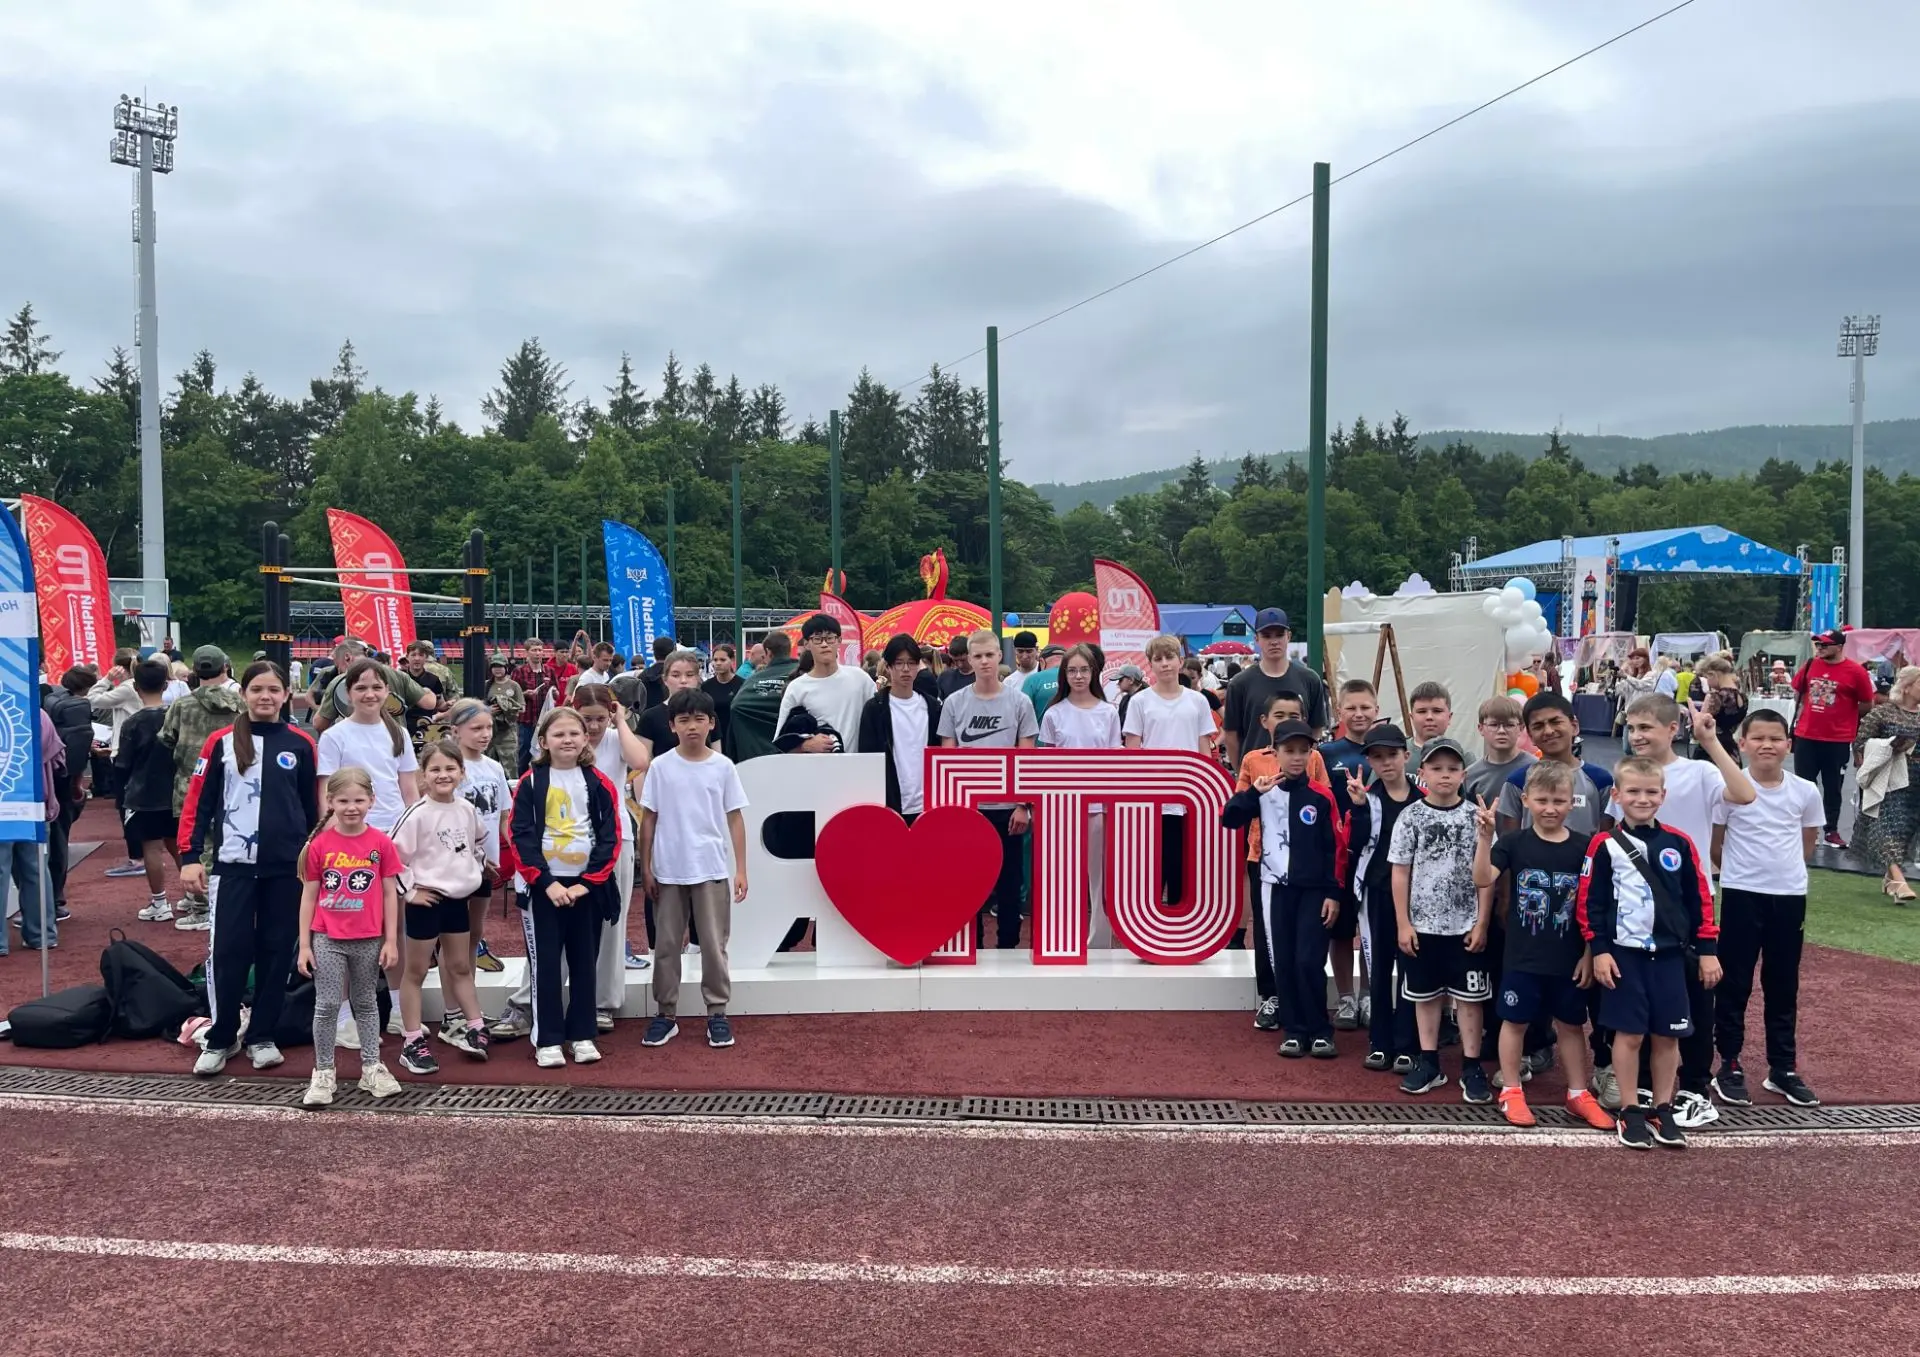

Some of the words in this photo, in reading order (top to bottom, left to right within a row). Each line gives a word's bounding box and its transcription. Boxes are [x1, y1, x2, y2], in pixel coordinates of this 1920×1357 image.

[968, 716, 1002, 729] NIKE
[923, 747, 1244, 966] ГТО
[335, 894, 363, 909] Love
[1516, 868, 1580, 930] 67
